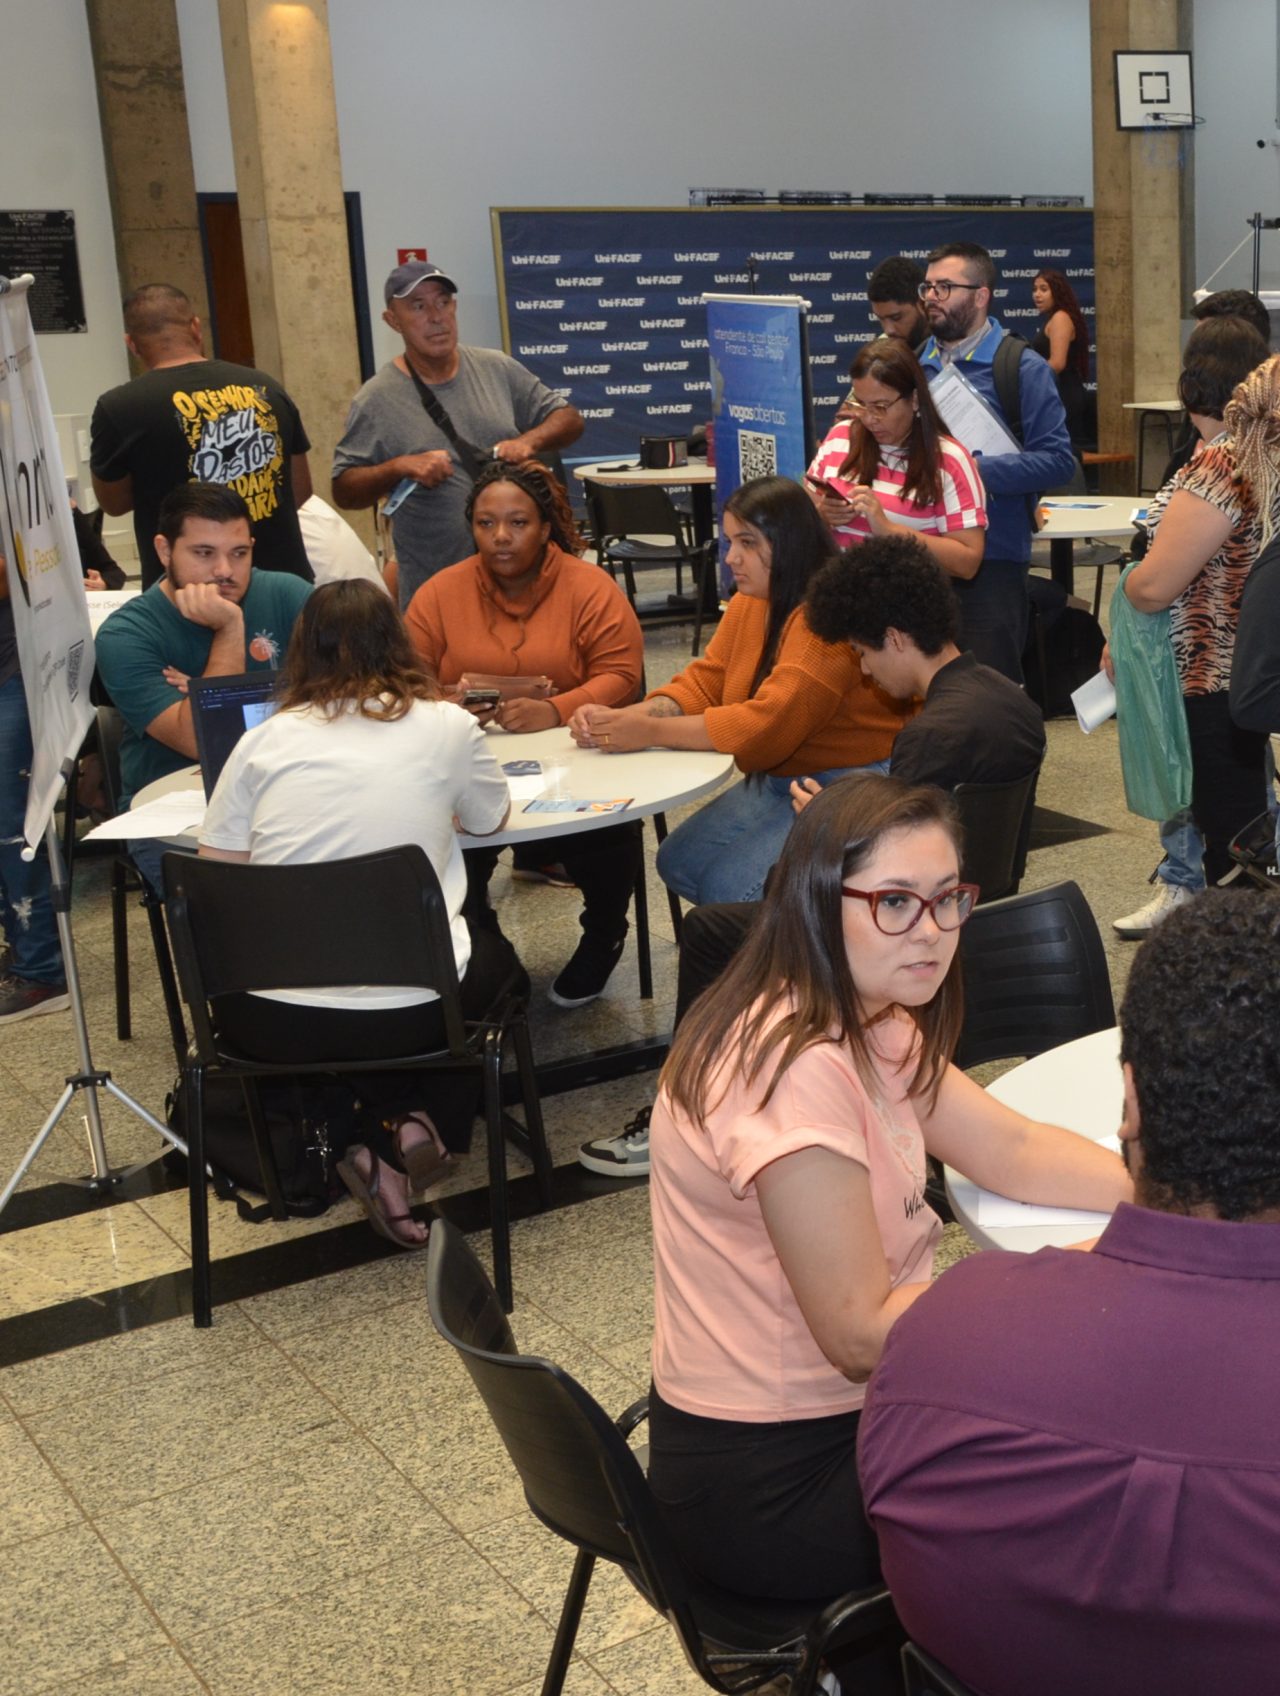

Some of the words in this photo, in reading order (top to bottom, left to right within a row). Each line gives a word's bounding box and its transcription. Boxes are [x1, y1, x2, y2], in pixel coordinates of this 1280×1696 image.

[512, 255, 561, 264] Uni-FACEF
[595, 254, 642, 263] Uni-FACEF
[674, 253, 719, 262] Uni-FACEF
[829, 251, 872, 260] Uni-FACEF
[901, 250, 931, 258] Uni-FAC
[1034, 249, 1072, 258] Uni-FACEF
[556, 277, 604, 287] Uni-FACEF
[637, 275, 683, 285] Uni-FACEF
[789, 273, 832, 282] Uni-FACEF
[1066, 268, 1094, 277] Uni-FAC
[516, 300, 565, 310] Uni-FACEF
[598, 298, 645, 307] Uni-FACEF
[559, 321, 608, 331] Uni-FACEF
[640, 319, 686, 328] Uni-FACEF
[519, 345, 569, 355] Uni-FACEF
[602, 342, 648, 351] Uni-FACEF
[563, 365, 611, 375] Uni-FACEF
[643, 361, 689, 371] Uni-FACEF
[606, 384, 652, 394] Uni-FACEF
[647, 404, 692, 414] Uni-FACEF
[201, 409, 256, 450] MEU
